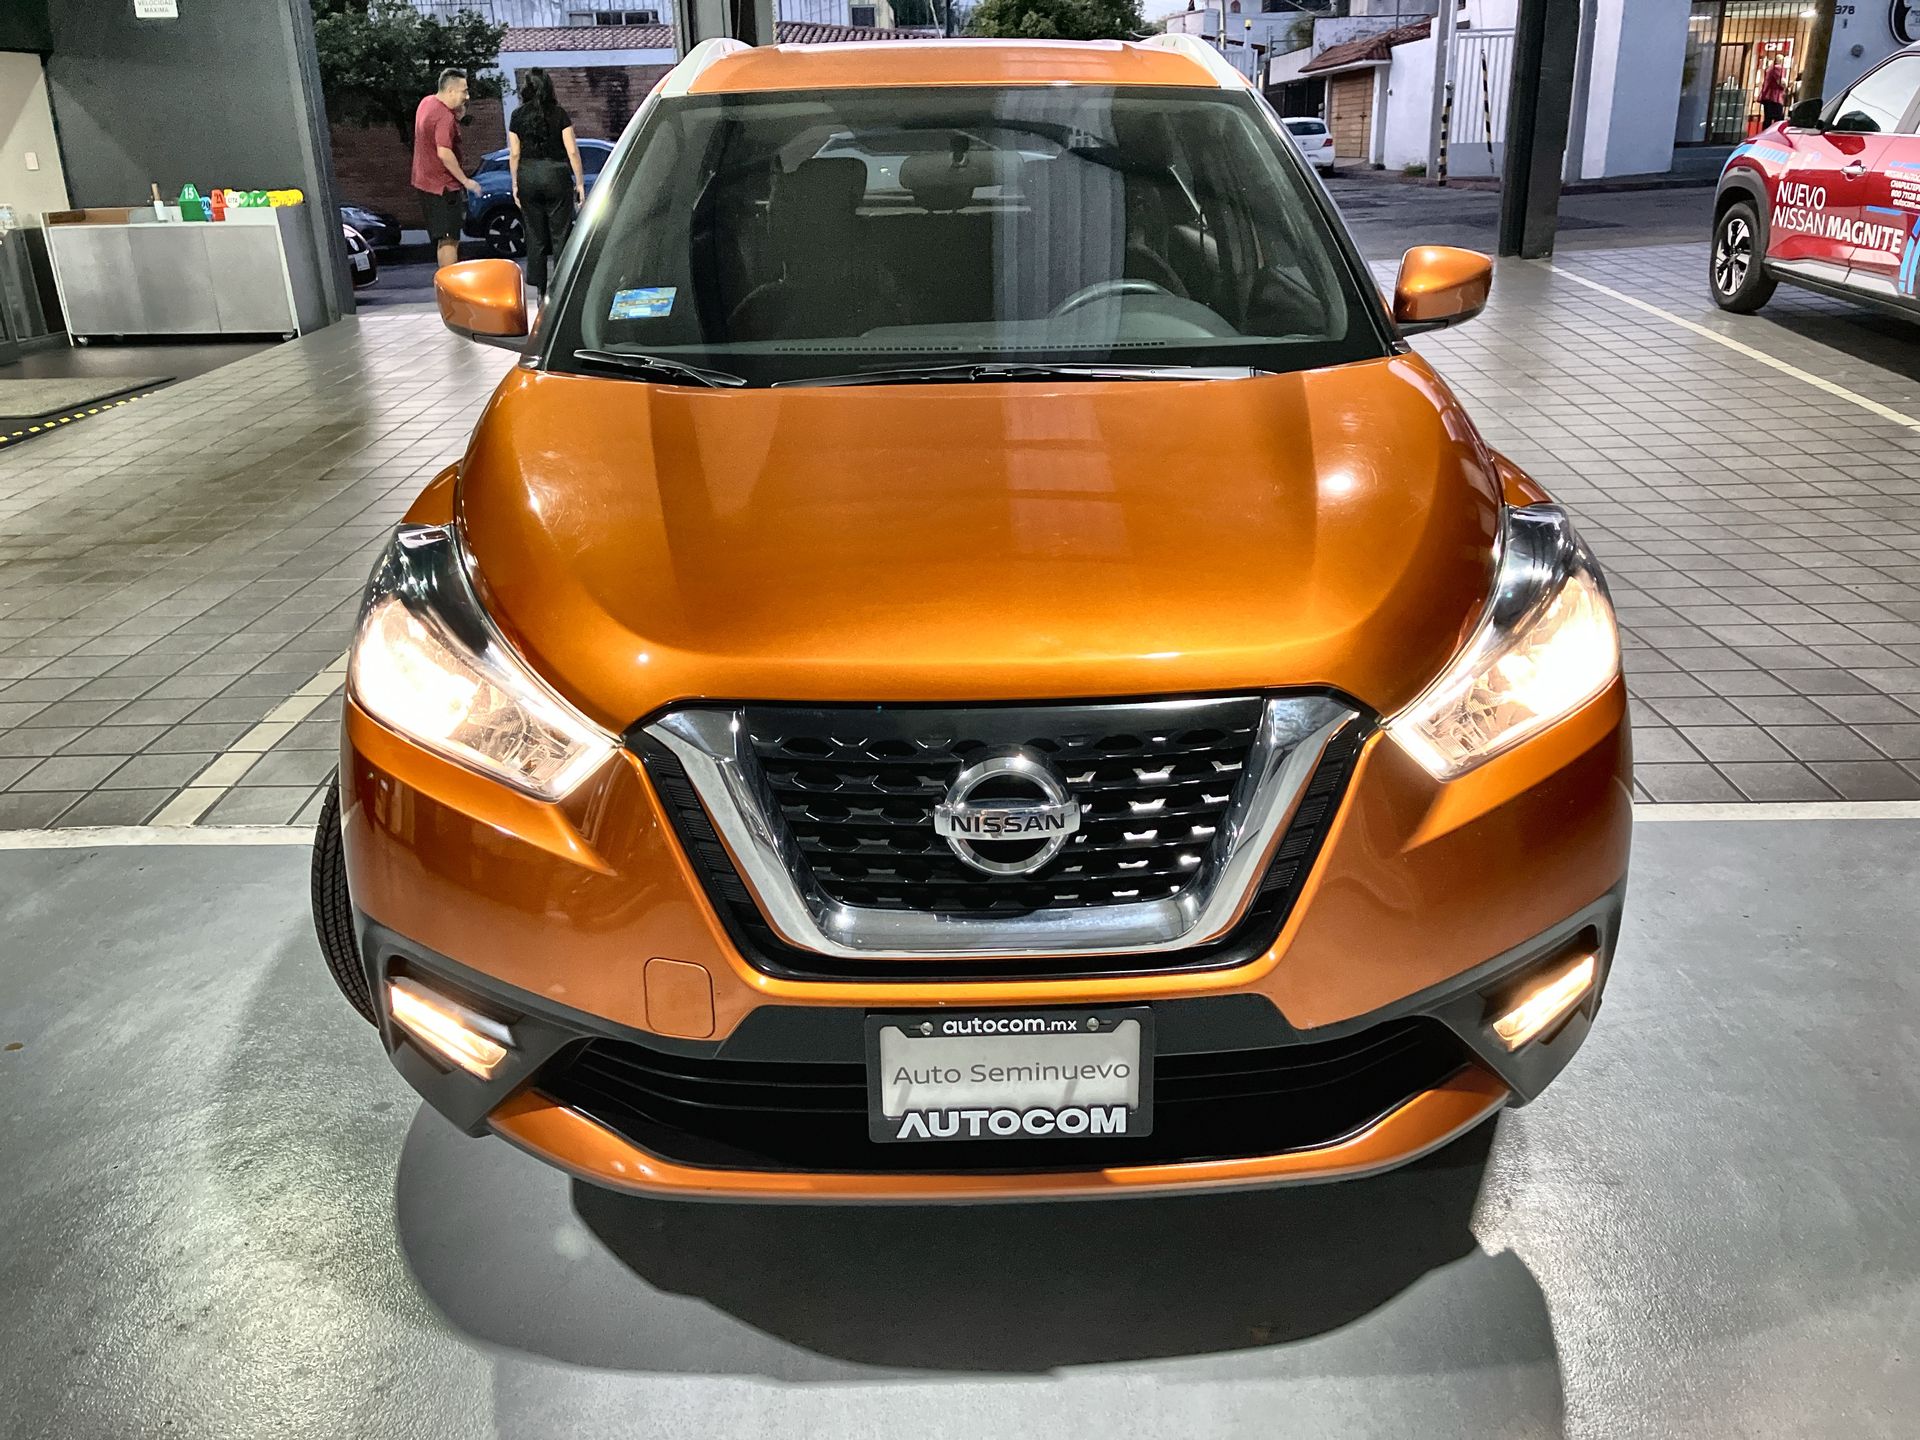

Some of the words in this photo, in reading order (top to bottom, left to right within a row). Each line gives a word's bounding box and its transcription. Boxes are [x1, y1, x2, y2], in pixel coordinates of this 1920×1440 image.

[184, 187, 195, 200] 15
[1775, 181, 1826, 210] NUEVO
[1772, 205, 1826, 236] NISSAN
[1825, 215, 1905, 254] MAGNITE
[950, 813, 1065, 833] NISSAN
[942, 1017, 1078, 1034] autocom.mx
[893, 1066, 962, 1085] Auto
[970, 1062, 1130, 1083] Seminuevo
[896, 1107, 1127, 1139] AUTOCOM
